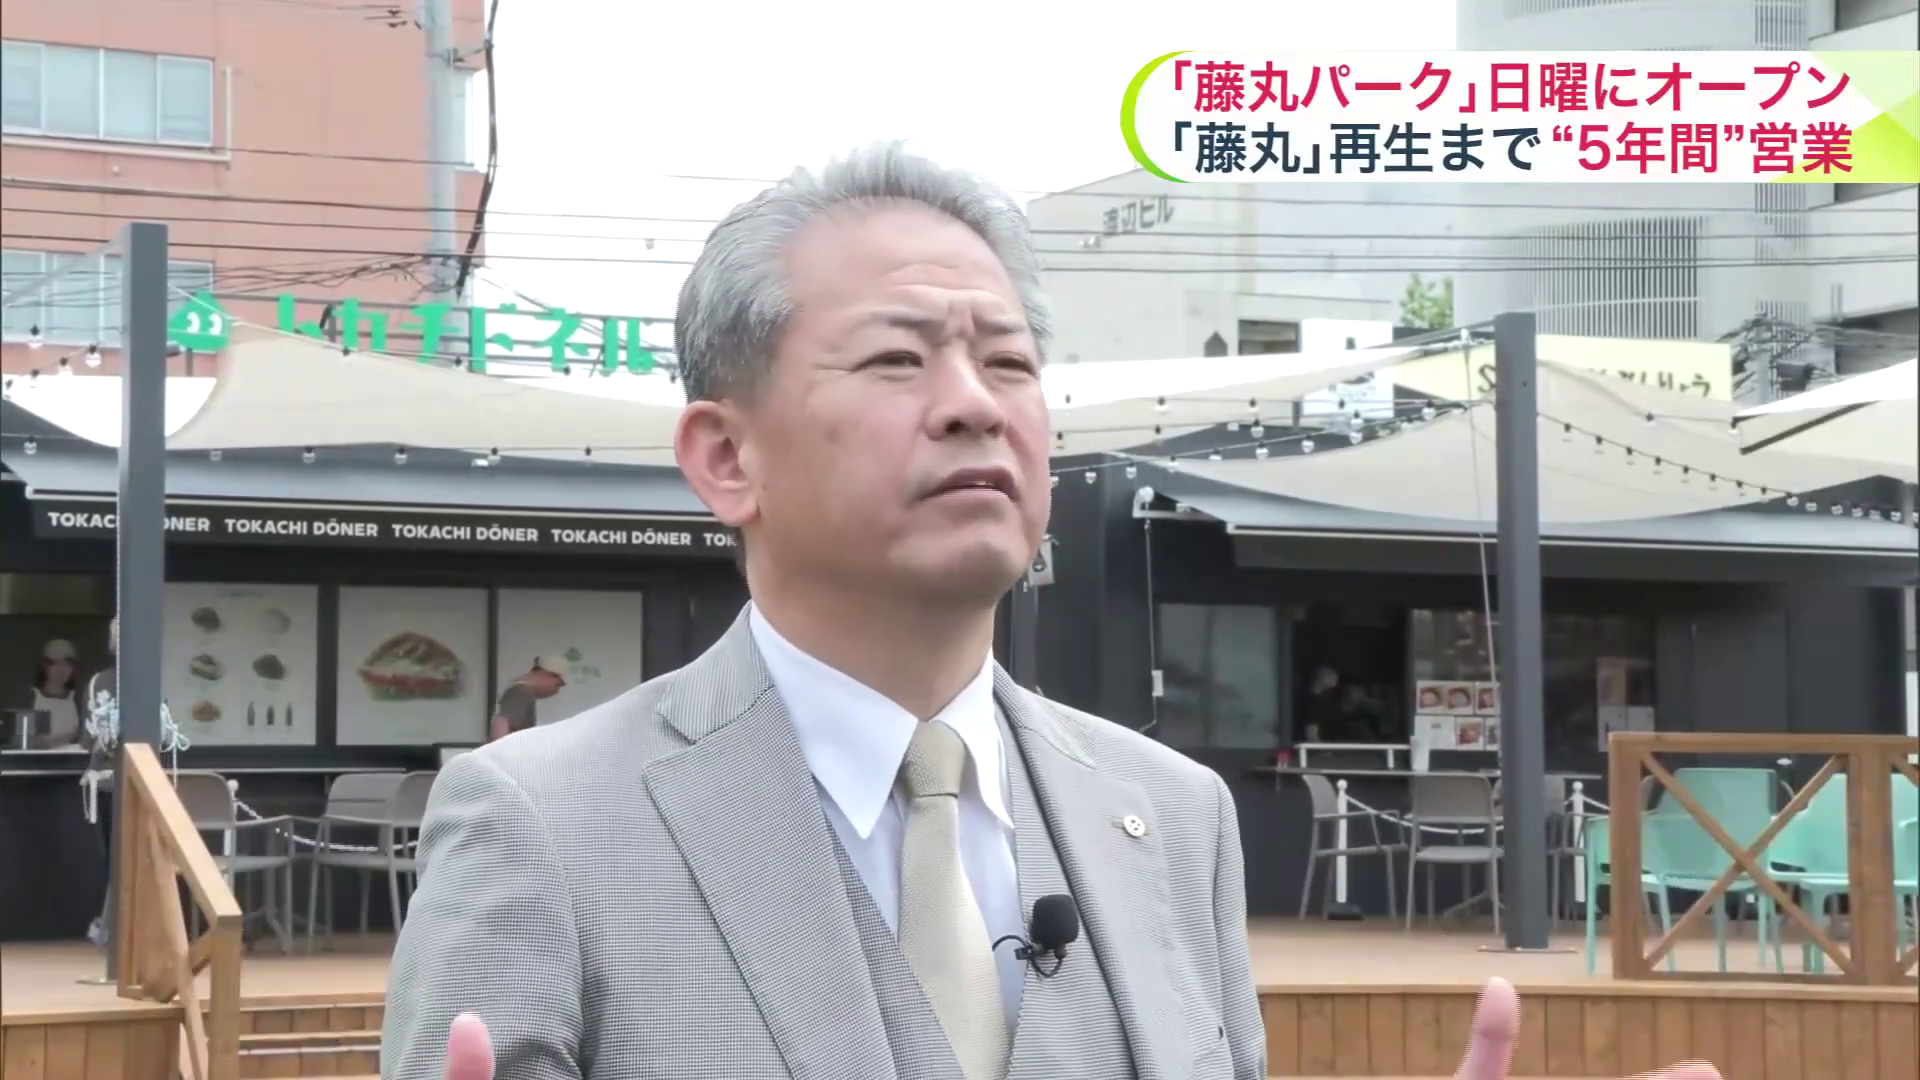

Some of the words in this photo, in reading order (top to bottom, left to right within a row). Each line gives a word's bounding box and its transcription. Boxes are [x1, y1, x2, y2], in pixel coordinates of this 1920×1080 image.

[224, 518, 308, 535] TOKACHI
[312, 517, 379, 537] DÖNER
[391, 523, 472, 540] TOKACHI
[475, 523, 539, 542] DÖNER
[550, 528, 627, 544] TOKACHI
[631, 528, 692, 546] DÖNER
